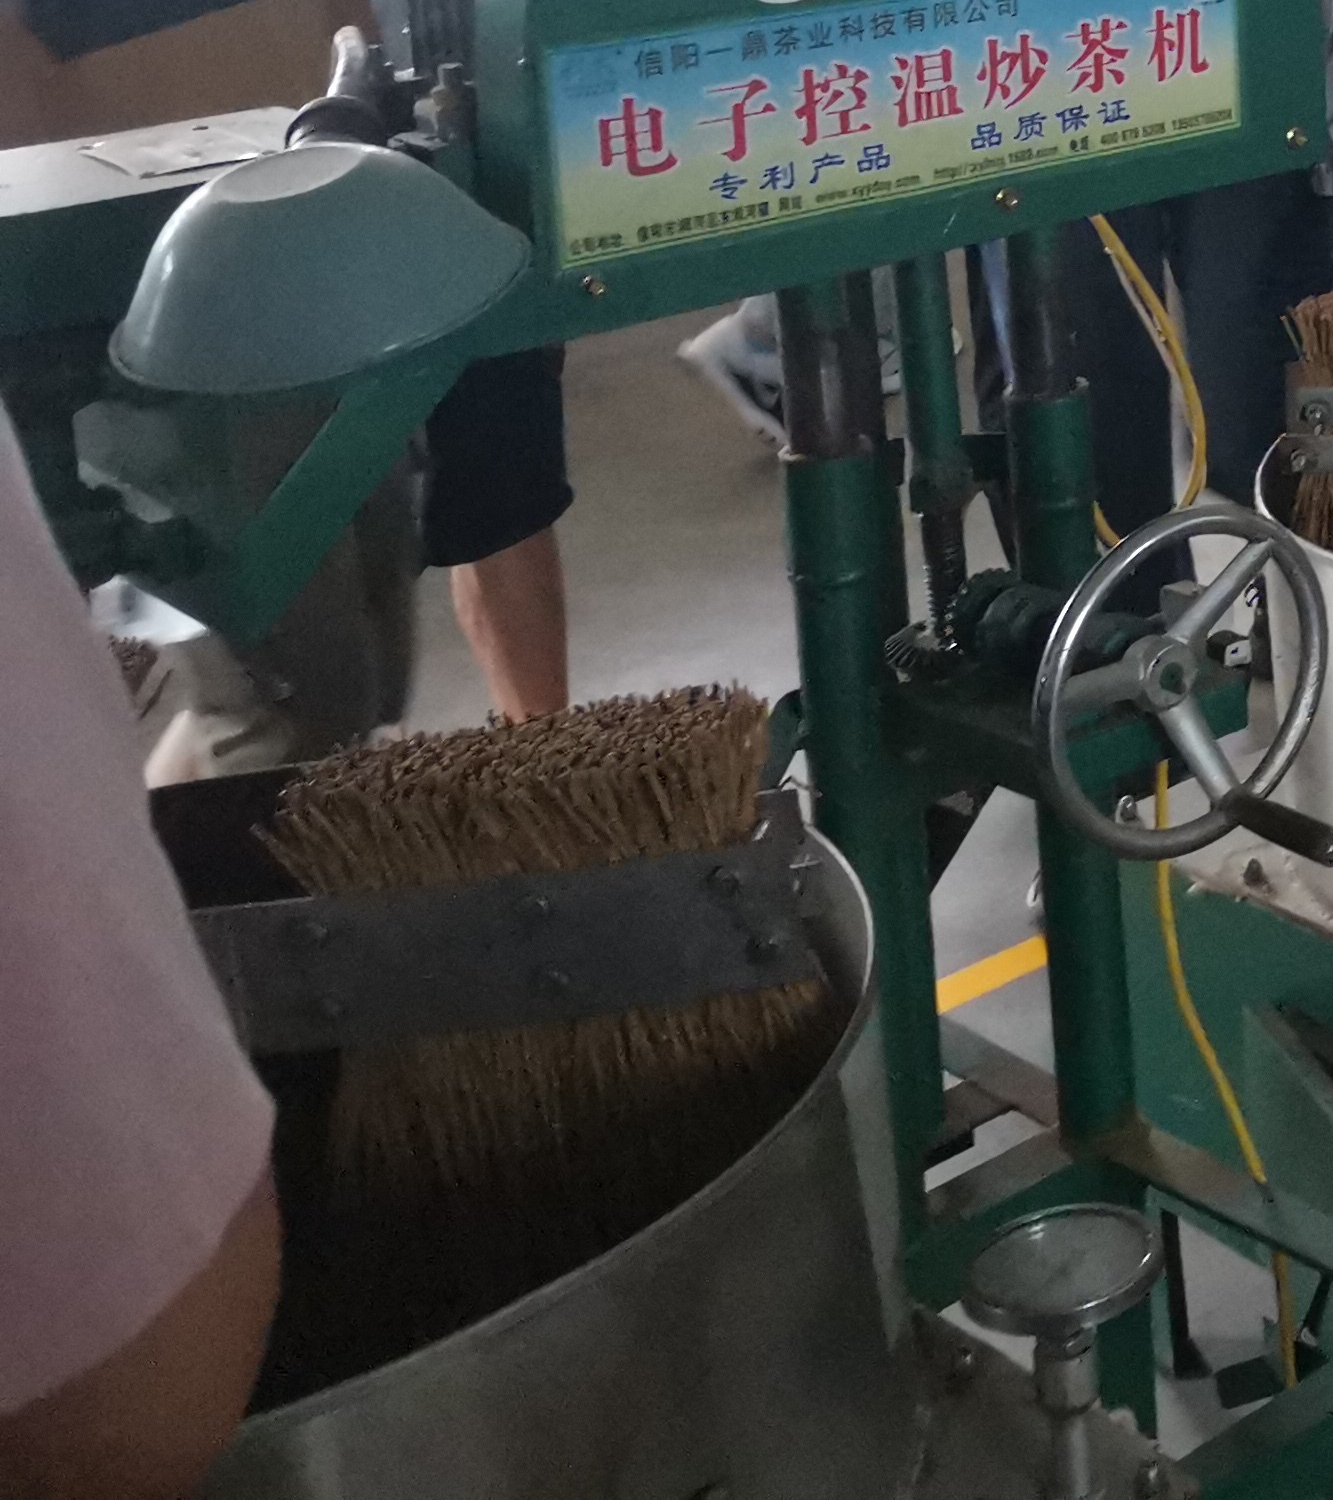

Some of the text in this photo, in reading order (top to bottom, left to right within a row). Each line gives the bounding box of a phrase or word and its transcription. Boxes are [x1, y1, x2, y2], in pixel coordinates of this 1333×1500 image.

[595, 6, 1211, 179] 电子控温炒茶机
[708, 142, 893, 200] 专利产品
[970, 99, 1132, 152] 品质保证
